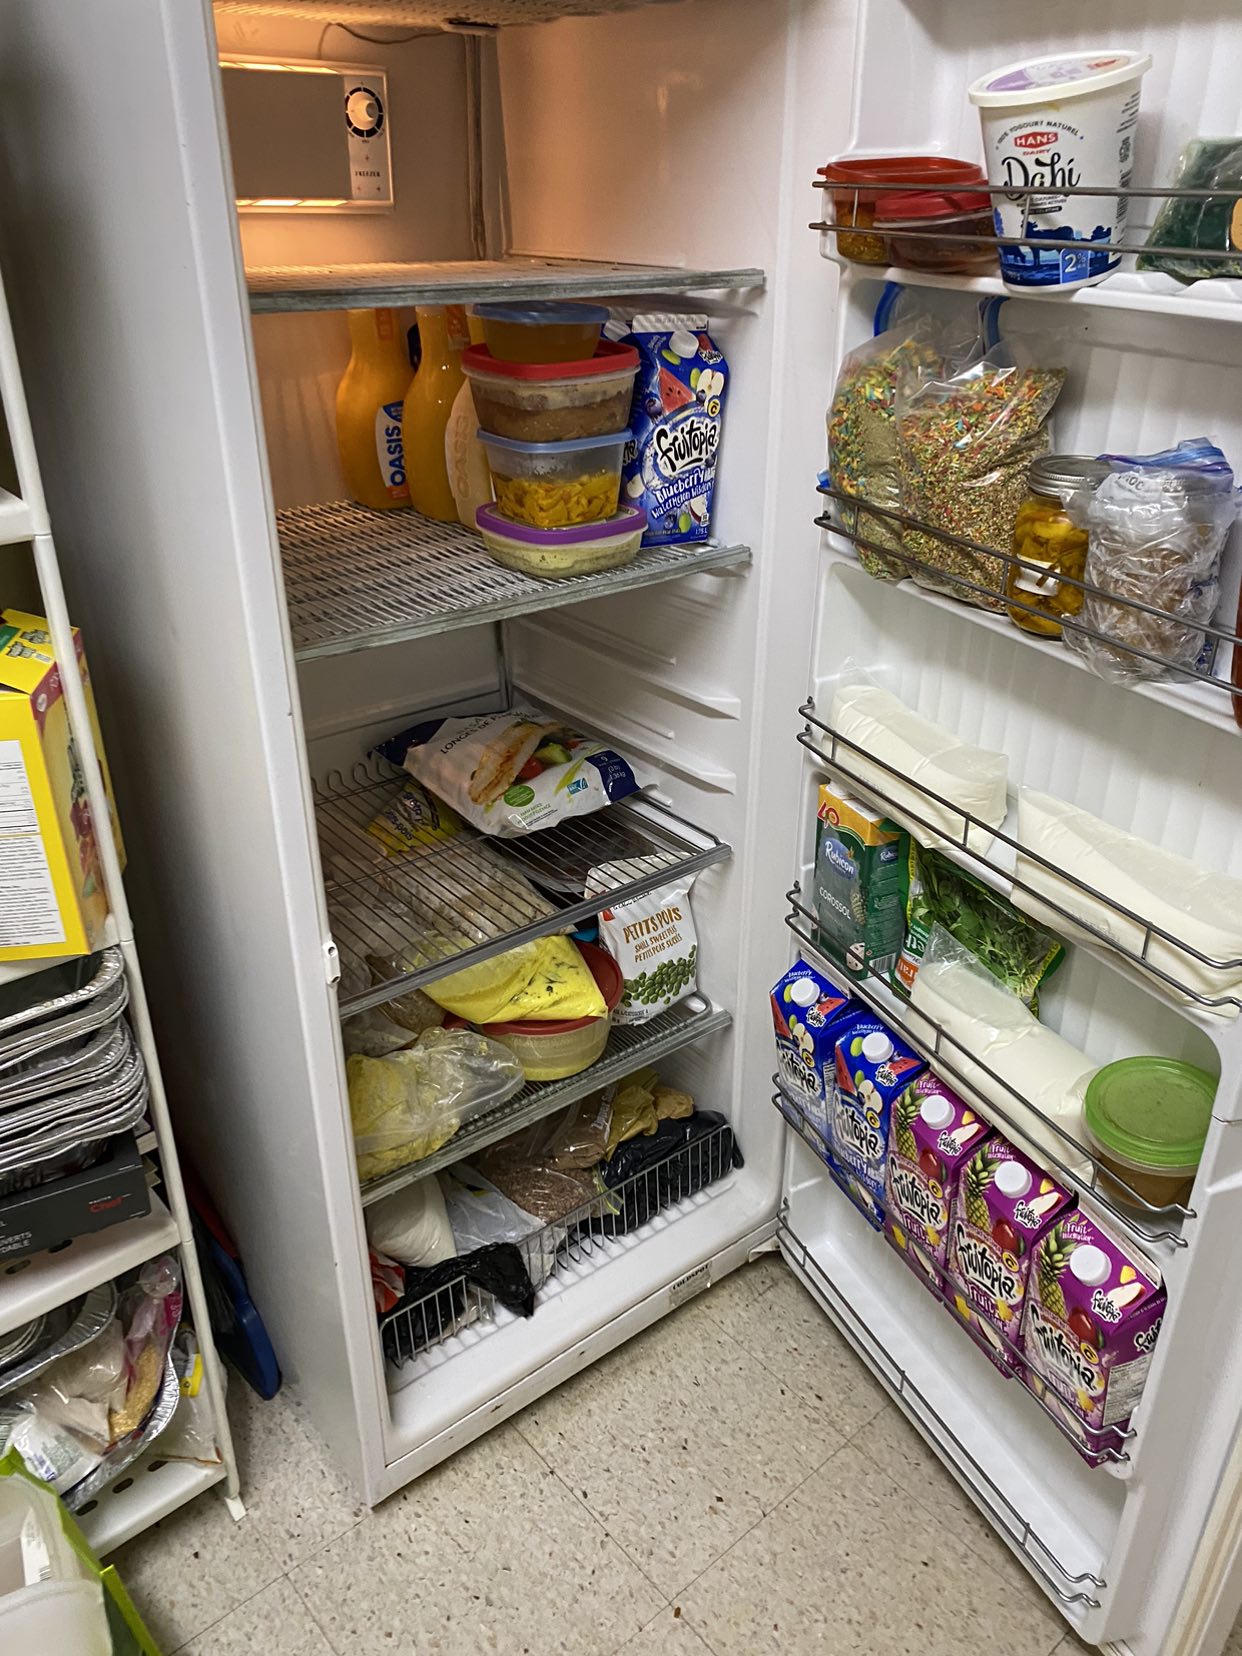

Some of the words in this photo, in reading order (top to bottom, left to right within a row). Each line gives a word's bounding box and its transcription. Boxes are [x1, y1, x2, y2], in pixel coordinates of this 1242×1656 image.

[1016, 132, 1057, 147] HANS
[385, 425, 406, 487] OASIS
[440, 728, 479, 754] LONGES
[825, 840, 855, 875] Rubicon
[819, 886, 852, 920] COROSSOL
[623, 915, 658, 944] PETITS
[657, 906, 683, 928] POIS
[649, 932, 668, 946] SWEET
